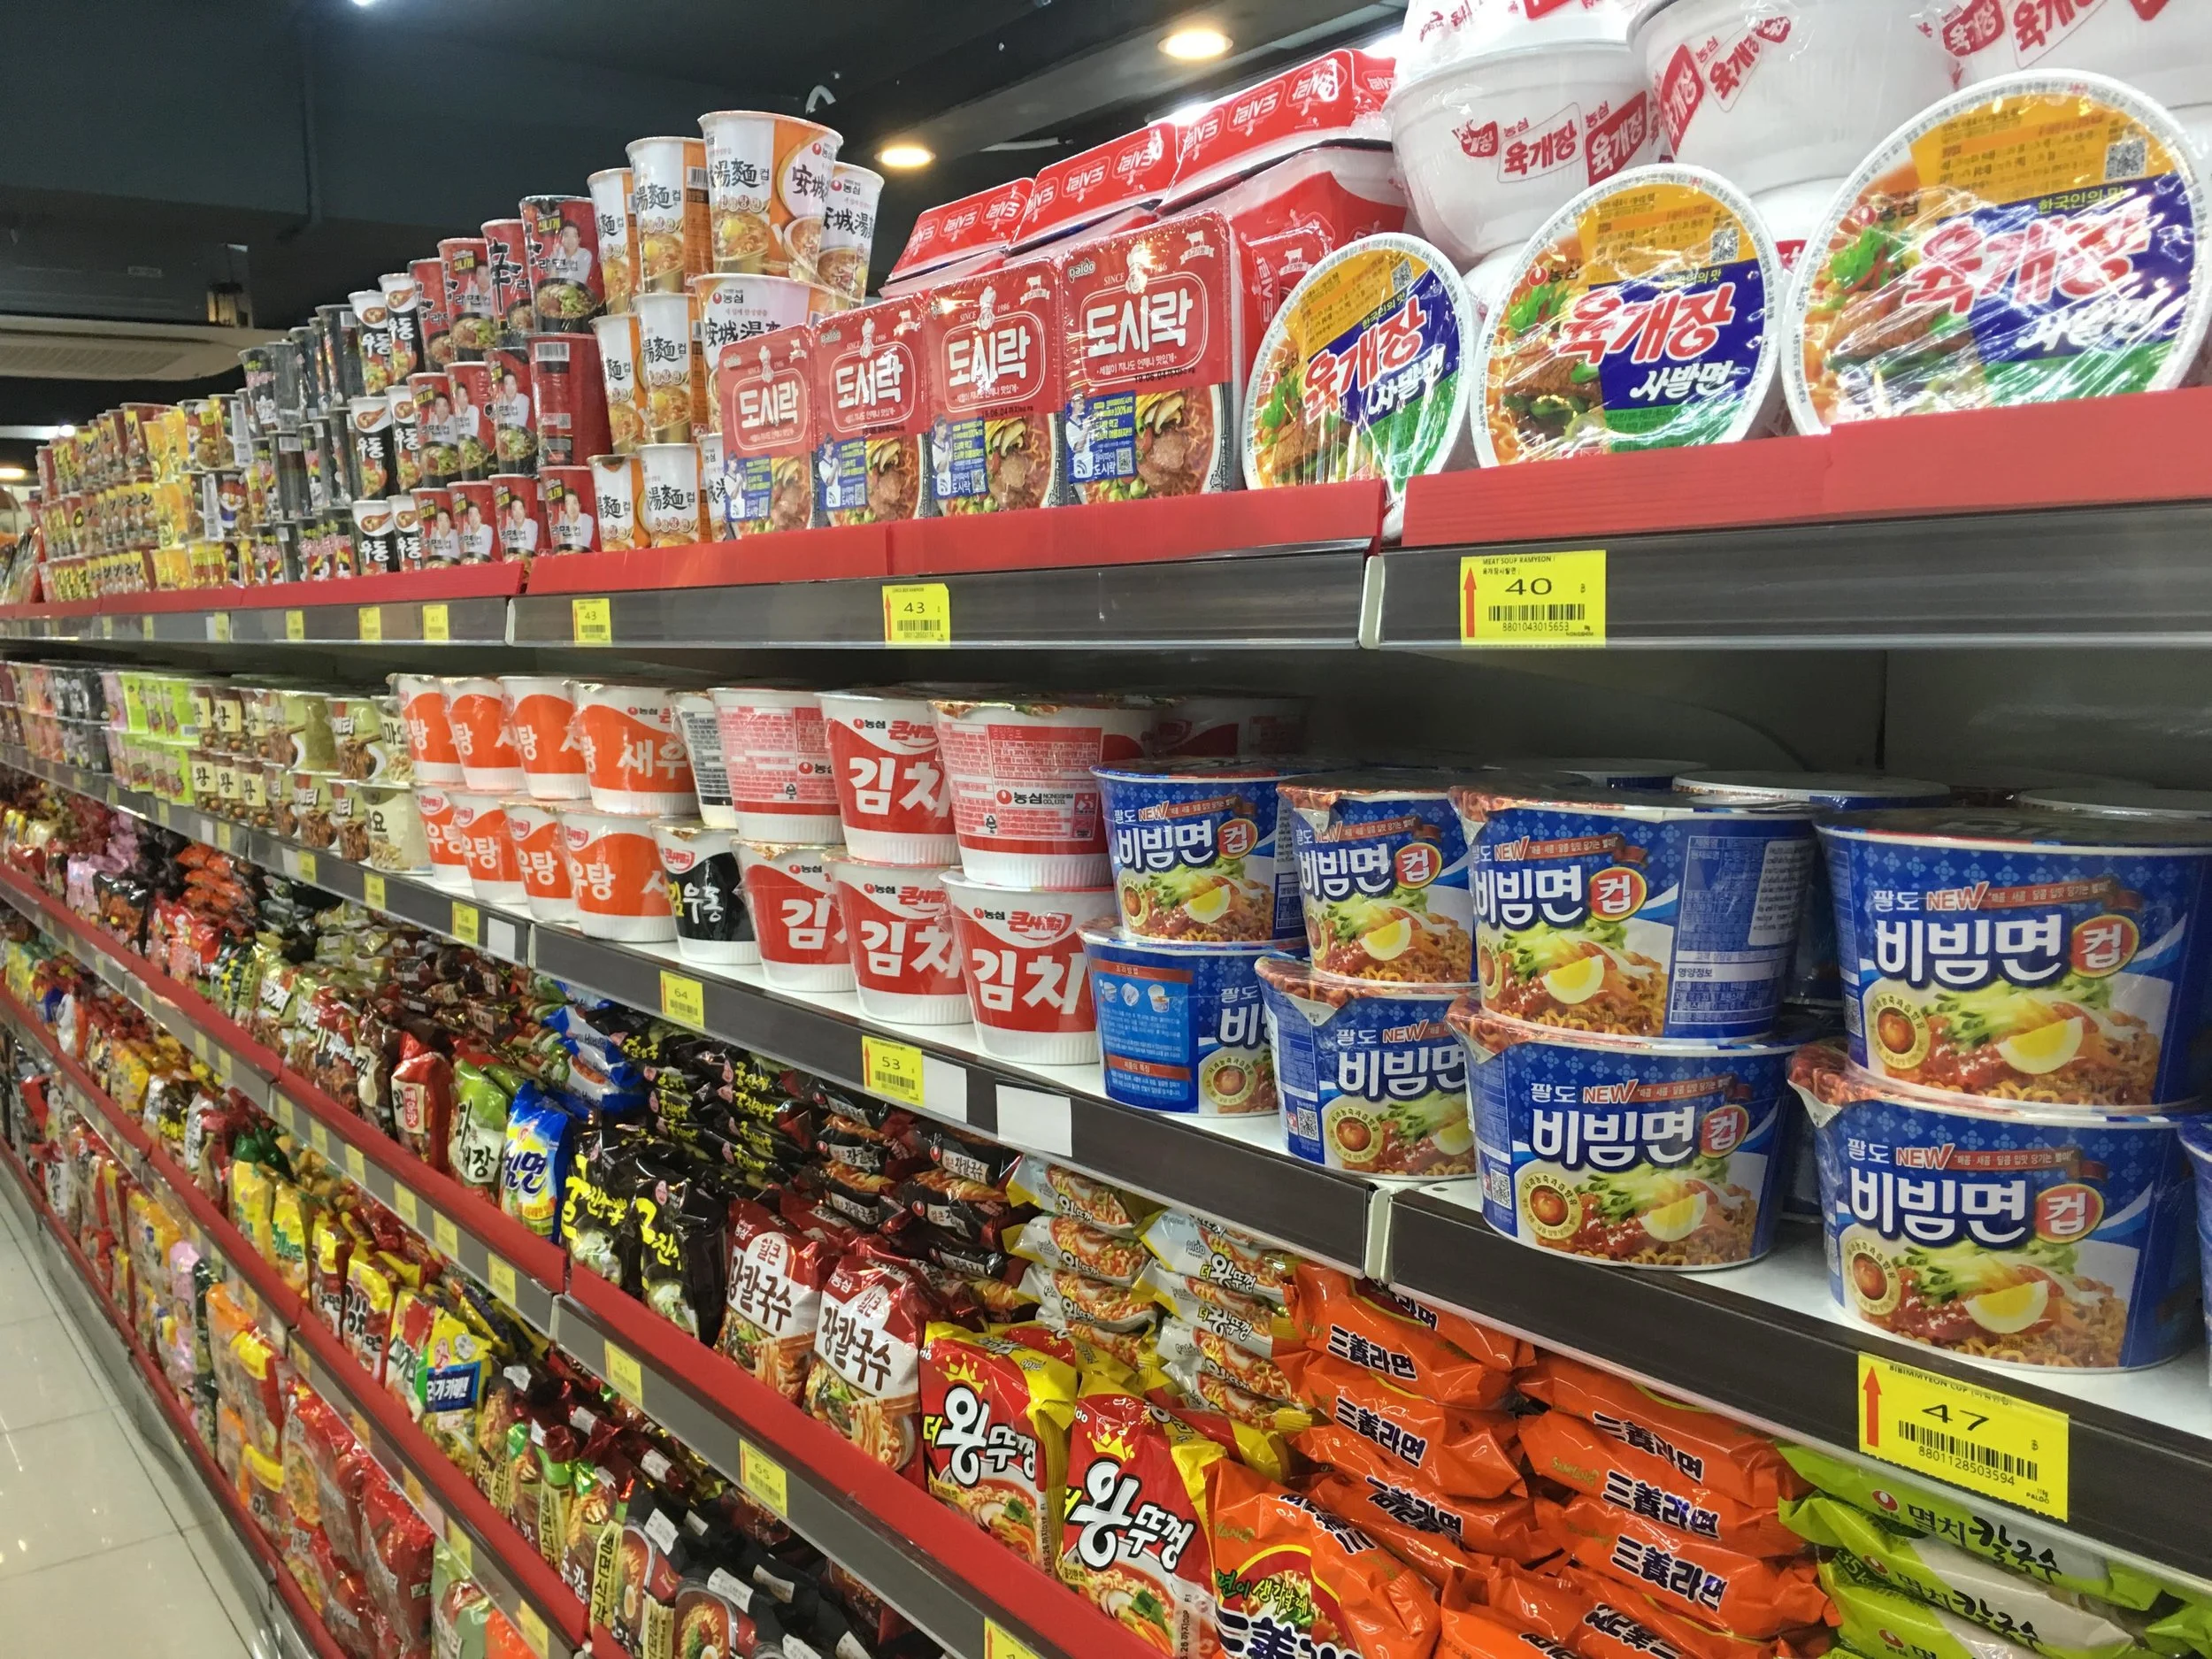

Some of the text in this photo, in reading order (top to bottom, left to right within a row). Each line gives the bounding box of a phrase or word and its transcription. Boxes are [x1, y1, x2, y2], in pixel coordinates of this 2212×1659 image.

[1232, 92, 1279, 127] 도시락
[1504, 120, 1578, 175] 육개장
[1591, 105, 1647, 173] 육개장
[842, 183, 861, 196] 농심
[1065, 163, 1103, 190] 도시락
[985, 198, 1019, 222] 도시락
[2038, 191, 2106, 215] 한국인의
[943, 212, 978, 234] 도시락
[1068, 260, 1096, 282] paldo
[1103, 273, 1125, 286] SINCE
[723, 295, 744, 304] 농심
[959, 313, 977, 323] SINCE
[1087, 288, 1194, 357] 도시락
[1557, 281, 1736, 366] 육개장
[949, 325, 1031, 388] 도시락
[1303, 294, 1427, 425] 육개장
[836, 349, 903, 410] 도시락
[1630, 360, 1735, 401] 사발면
[739, 380, 799, 429] 도시락
[1505, 577, 1553, 595] 40
[584, 611, 597, 621] 43
[903, 602, 926, 614] 43
[1502, 620, 1570, 632] 8801043015653
[864, 718, 886, 730] 농심
[617, 738, 687, 779] 새우
[849, 757, 951, 818] 김치
[1014, 792, 1042, 804] 농심
[1114, 801, 1170, 823] 팔도 NEW
[1117, 818, 1215, 869] 비빔면
[1222, 827, 1249, 855] 컵
[1494, 836, 1531, 862] NEW
[801, 864, 823, 874] 농심
[1298, 843, 1430, 897] 비빔면 컵
[874, 884, 896, 895] 농심
[1471, 864, 1632, 926] 비빔면 컵
[1873, 890, 1920, 912] 팔도
[1926, 881, 1990, 911] NEW
[984, 909, 1005, 921] 농심
[861, 920, 963, 979] 김치
[1875, 913, 2123, 984] 비빔면 컵
[973, 948, 1087, 1015] 김치
[1678, 967, 1714, 979] 영양정보
[673, 988, 689, 1000] 64
[1220, 986, 1258, 1003] 팔도
[1336, 1019, 1430, 1045] 팔도 NEW
[882, 1056, 901, 1071] 53
[1337, 1044, 1468, 1097] 비빔면
[1531, 1082, 1577, 1104] 팔도
[1582, 1079, 1639, 1105] NEW
[1532, 1105, 1738, 1168] 비빔면 컵
[1847, 1137, 1889, 1164] 팔도
[1896, 1144, 1954, 1170] NEW
[1849, 1166, 2086, 1245] 비빔면 컵
[1200, 1264, 1212, 1279] 더
[728, 1254, 794, 1332] 장칼국수
[820, 1305, 892, 1392] 장칼국수
[1327, 1324, 1418, 1382] 三養라면
[1889, 1363, 1947, 1387] BIBIMMYEON
[1334, 1394, 1428, 1469] 三養라면
[1922, 1403, 1990, 1432] 47
[923, 1384, 1038, 1487] 더 왕뚜껑
[755, 1463, 772, 1480] 65
[1918, 1445, 2016, 1486] 8801128503594
[1601, 1470, 1722, 1541] 三養라면
[2026, 1491, 2050, 1504] PALDO
[1070, 1458, 1195, 1572] 왕뚜껑
[1610, 1535, 1729, 1613] 三養라면
